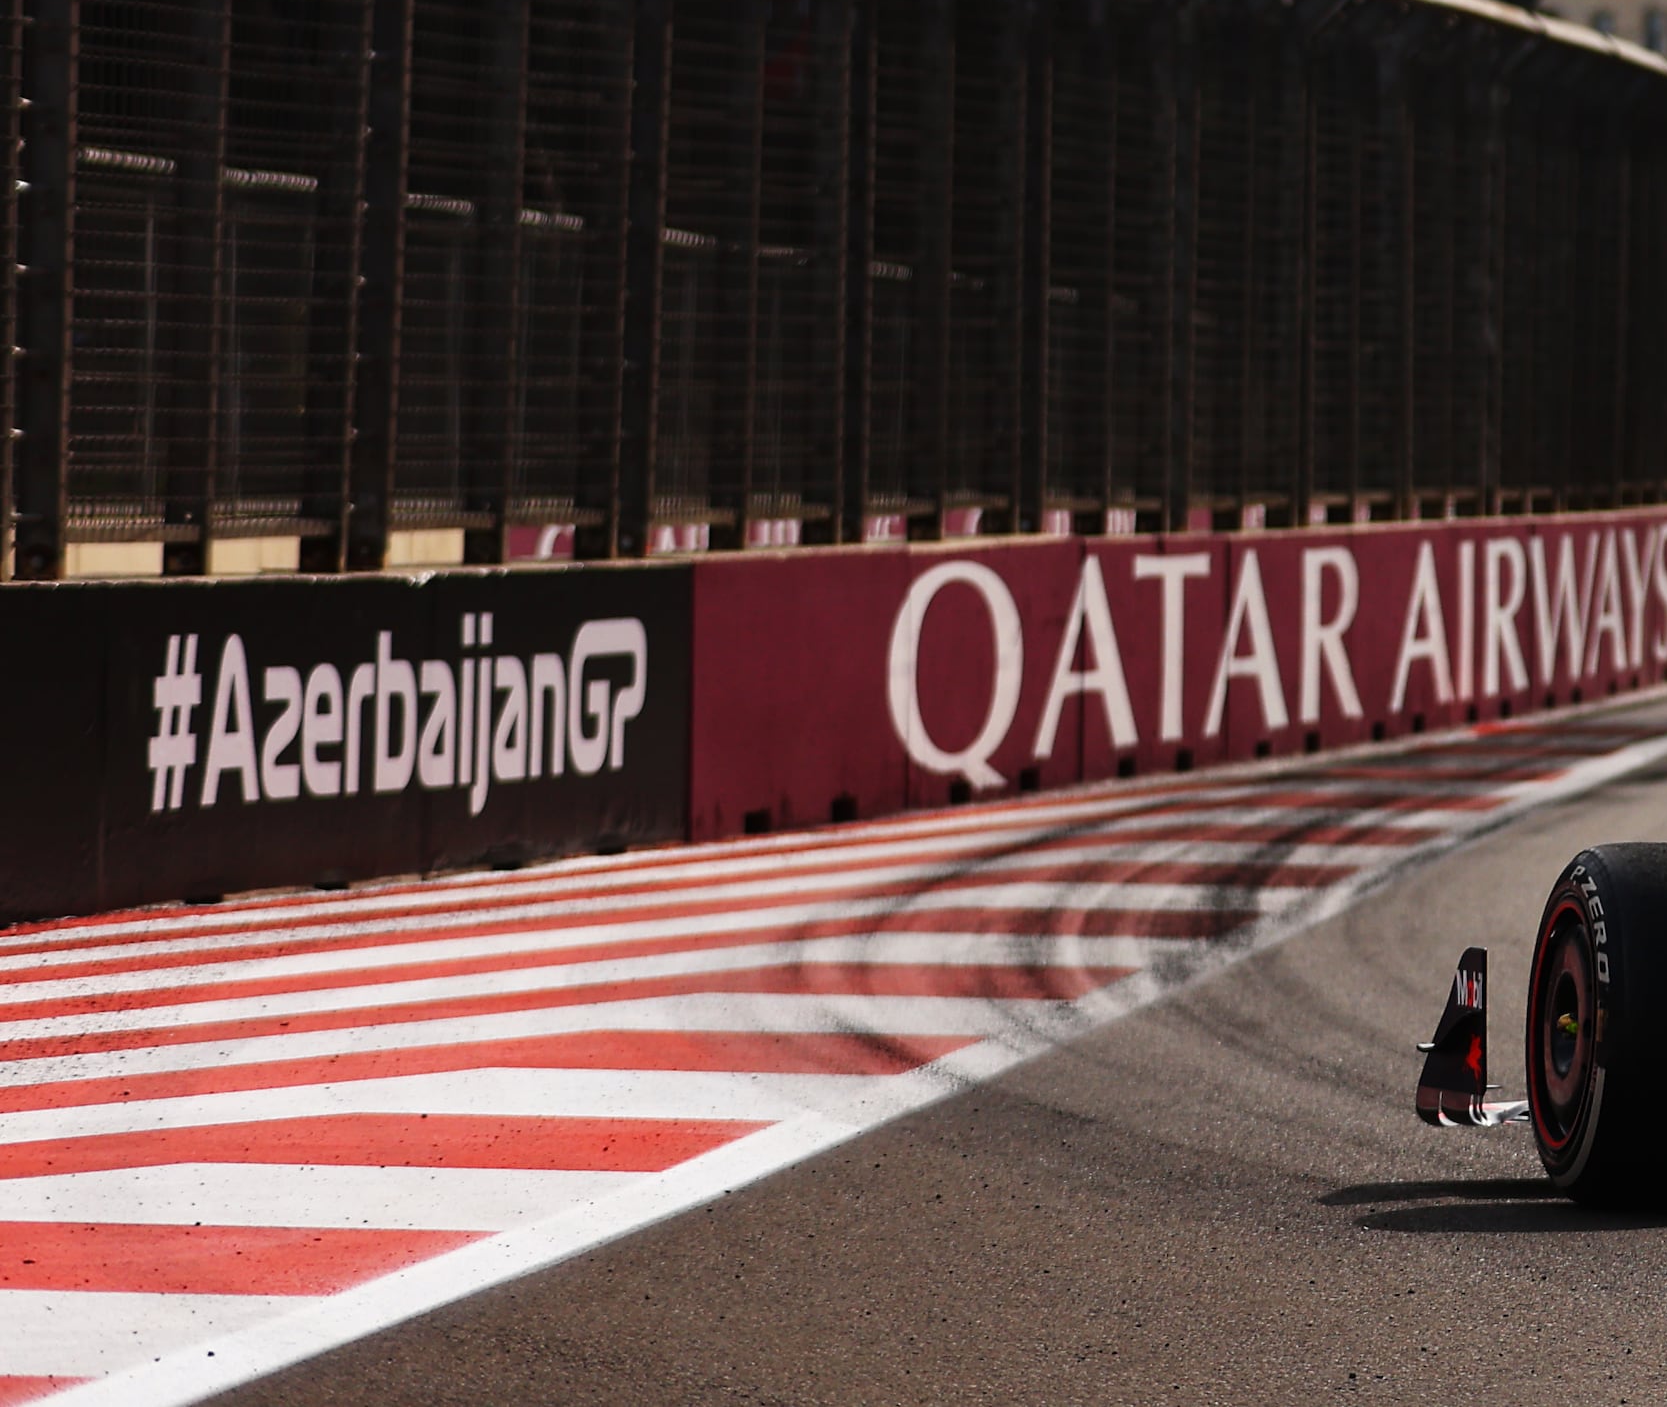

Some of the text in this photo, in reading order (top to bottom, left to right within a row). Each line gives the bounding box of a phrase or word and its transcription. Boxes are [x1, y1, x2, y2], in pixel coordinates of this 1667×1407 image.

[148, 611, 648, 818] #AzerbaijanGP
[888, 546, 1364, 790] QATAR
[1580, 875, 1611, 985] ZERO
